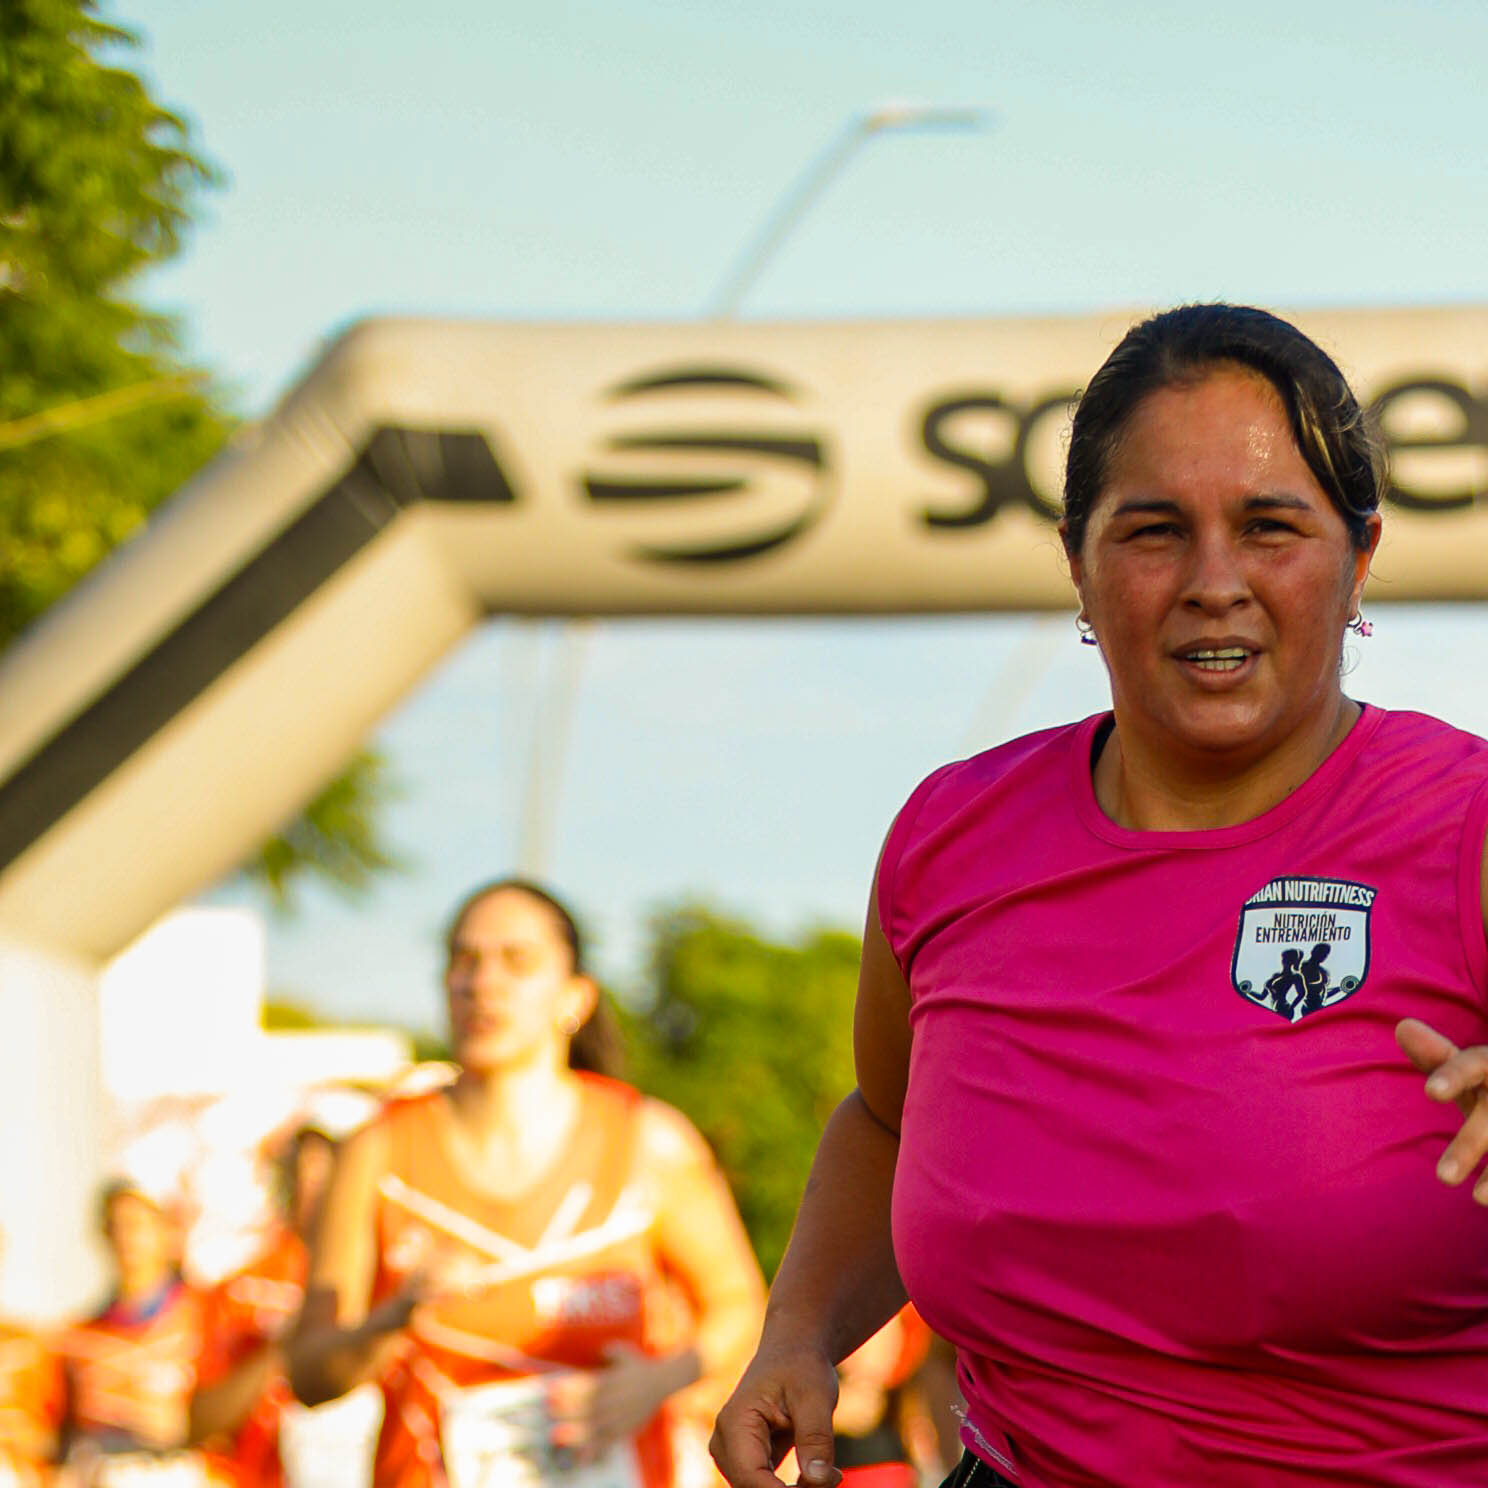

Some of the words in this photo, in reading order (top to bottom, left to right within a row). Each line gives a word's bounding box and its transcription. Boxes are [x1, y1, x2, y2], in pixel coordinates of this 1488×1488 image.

[1284, 880, 1375, 907] NUTRIFITNESS
[1274, 911, 1336, 928] NUTRICIÓN
[1256, 925, 1351, 943] ENTRENAMIENTO
